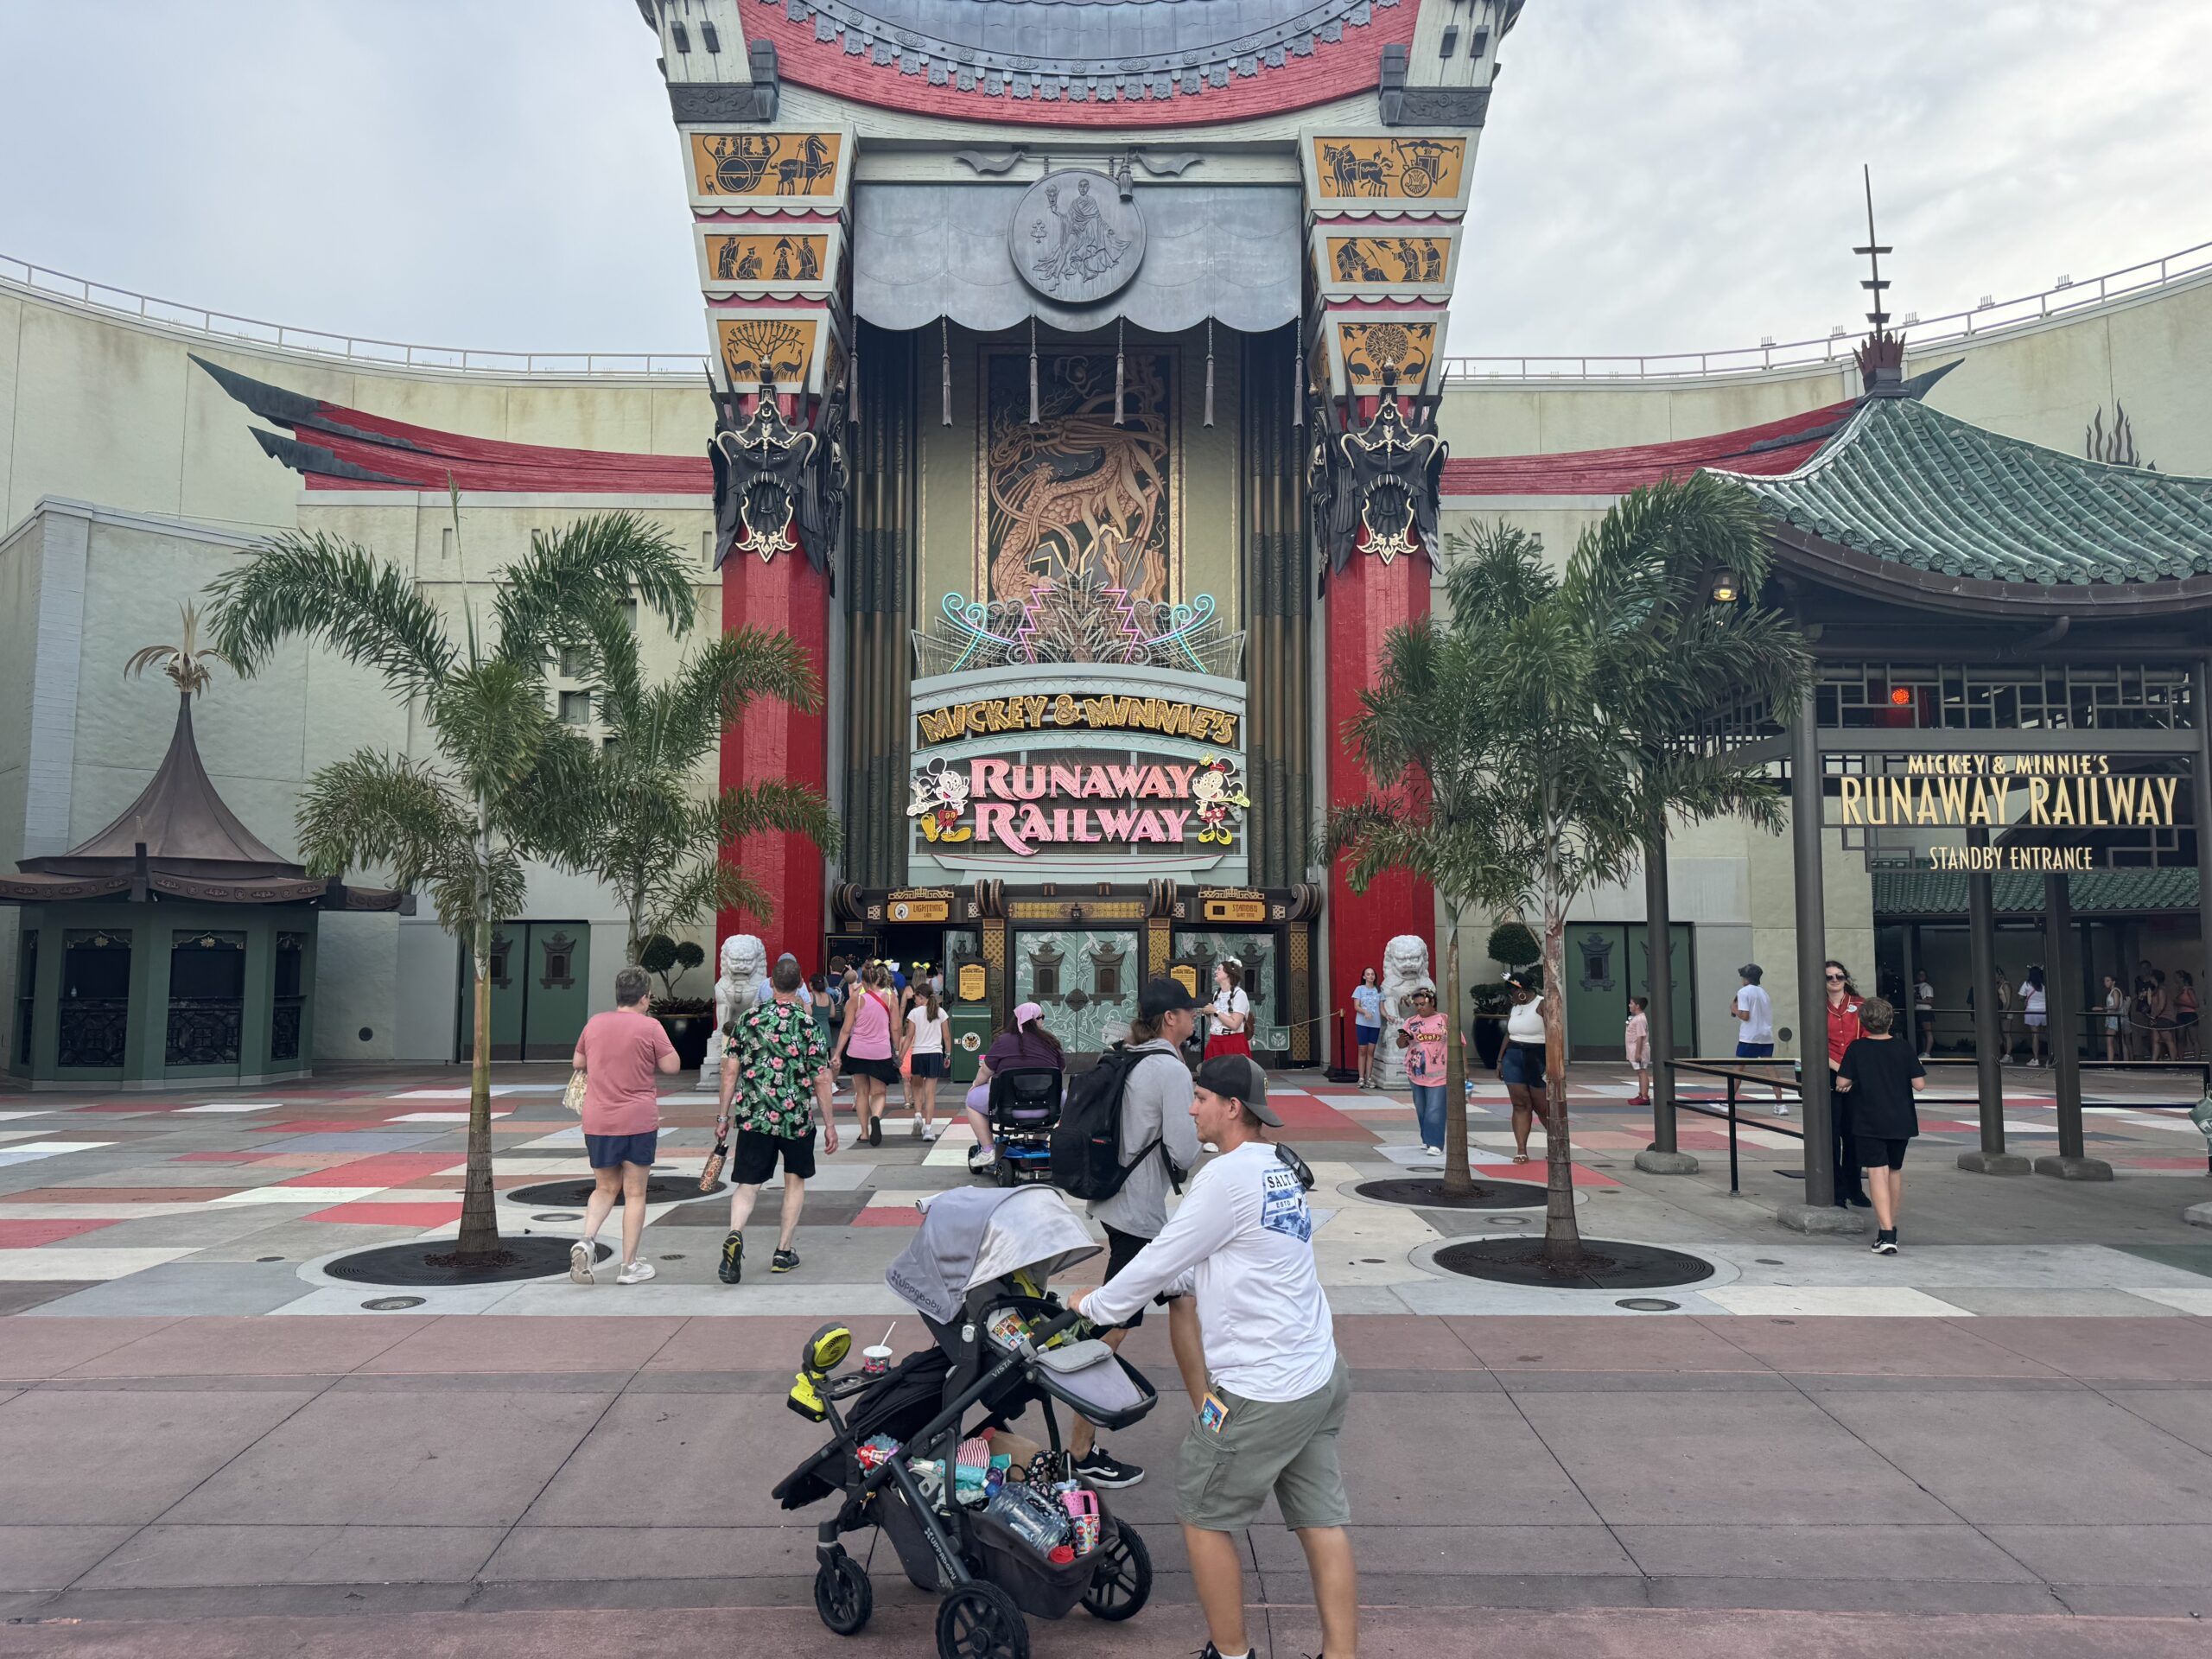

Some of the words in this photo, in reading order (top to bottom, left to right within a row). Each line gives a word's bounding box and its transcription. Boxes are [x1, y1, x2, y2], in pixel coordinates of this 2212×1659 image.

[918, 696, 1048, 741] MICKEY
[1054, 695, 1081, 725] &
[1083, 695, 1237, 744] MINNIE'S
[1907, 754, 1986, 774] MICKEY
[1993, 756, 2006, 774] &
[2015, 754, 2109, 775] MINNIE'S
[969, 759, 1198, 801] RUNAWAY
[1840, 777, 2011, 825] RUNAWAY
[2029, 777, 2177, 826] RAILWAY
[974, 803, 1192, 856] RAILWAY
[1929, 847, 2003, 870] STANDBY
[2009, 847, 2094, 870] ENTRANCE
[912, 904, 944, 912] LIGHTNING
[1232, 904, 1258, 912] STANDBY
[1267, 1174, 1292, 1189] SALT
[991, 1358, 1013, 1377] VISTA
